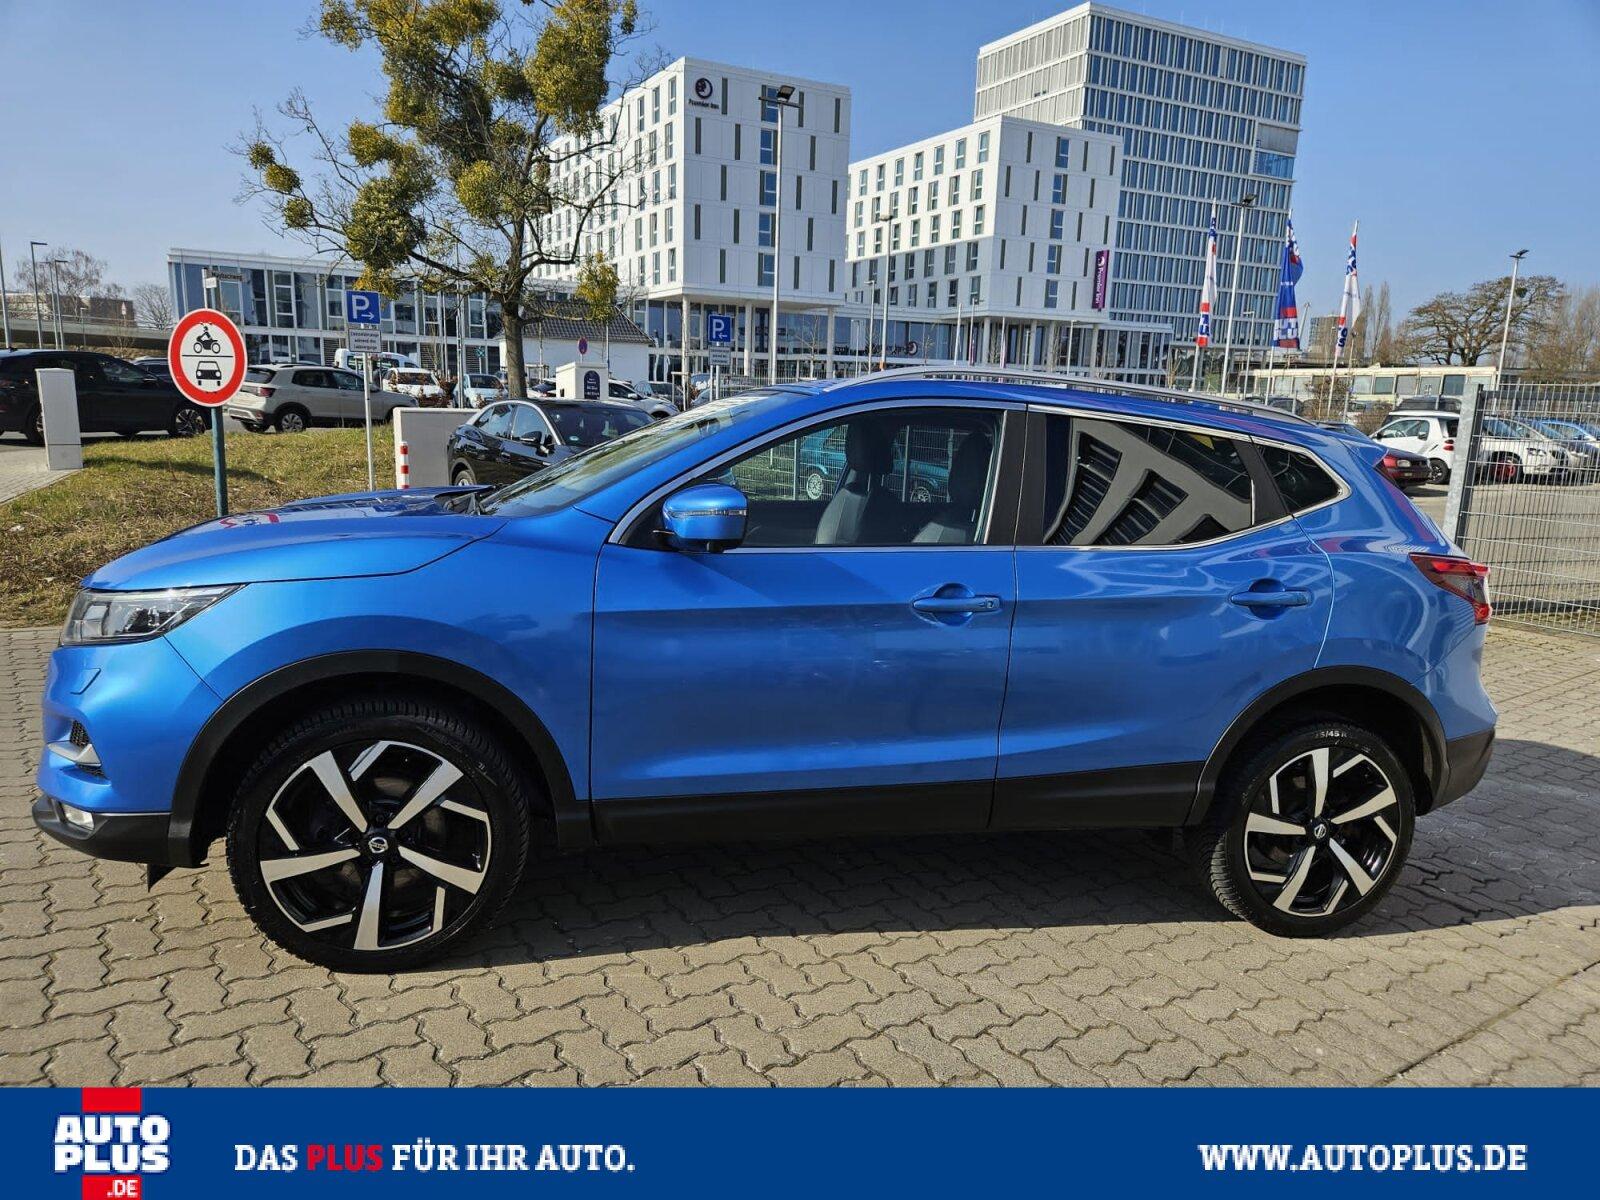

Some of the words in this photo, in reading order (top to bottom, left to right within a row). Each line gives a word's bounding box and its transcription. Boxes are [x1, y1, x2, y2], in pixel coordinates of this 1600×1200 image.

[1096, 267, 1104, 292] Premier
[352, 295, 370, 319] P
[712, 318, 725, 339] P
